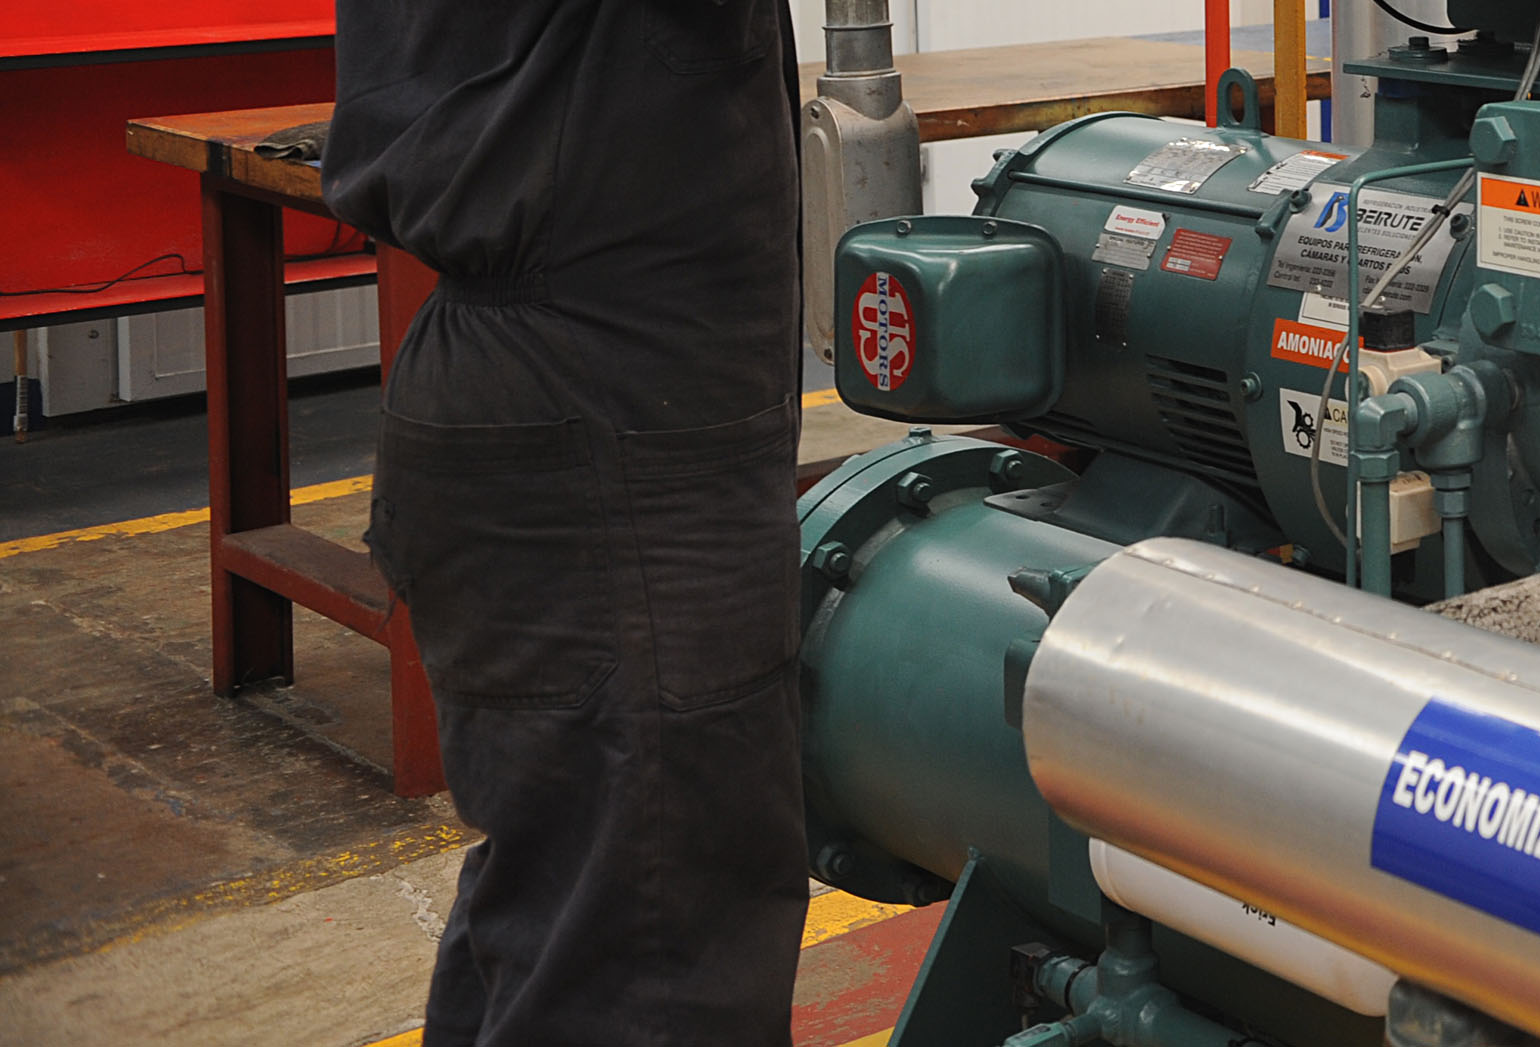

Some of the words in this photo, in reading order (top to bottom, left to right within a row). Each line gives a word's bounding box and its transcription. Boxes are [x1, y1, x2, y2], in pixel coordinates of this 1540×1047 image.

[1116, 214, 1135, 225] Energy
[1136, 217, 1160, 228] Efficient
[1357, 208, 1425, 232] BEIRUTE
[1298, 236, 1333, 250] EQUIPOS
[1341, 254, 1346, 264] Y
[859, 292, 909, 377] US
[878, 277, 888, 388] MOTORS
